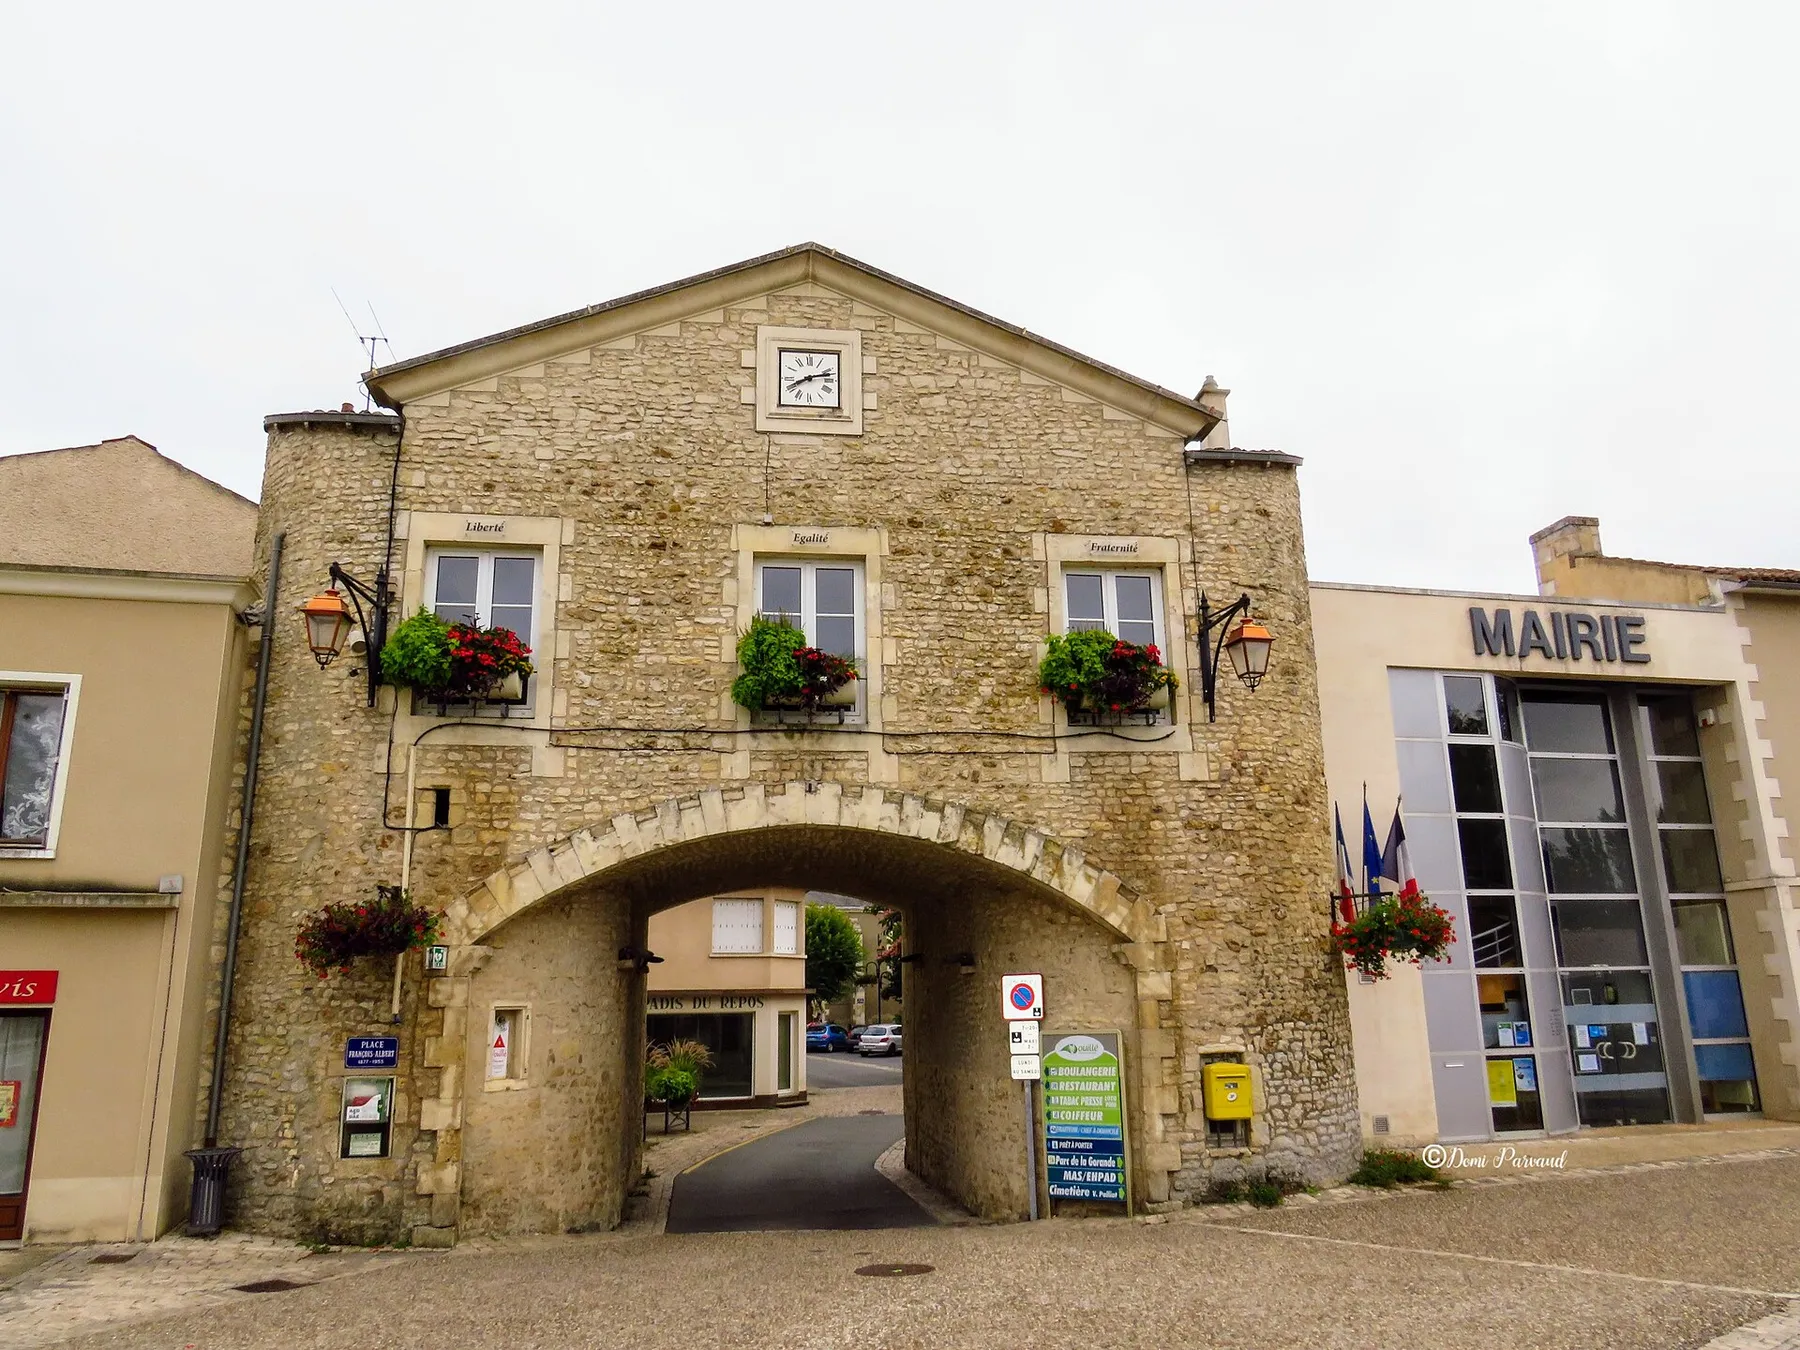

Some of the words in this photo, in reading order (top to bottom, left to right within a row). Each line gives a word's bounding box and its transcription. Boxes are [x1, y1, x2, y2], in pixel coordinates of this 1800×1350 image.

[465, 520, 505, 532] Liberté
[793, 532, 829, 545] Egalité
[1091, 541, 1138, 553] Fraternité
[1469, 607, 1651, 663] MAIRIE
[646, 996, 684, 1010] ADIS
[692, 996, 712, 1009] DU
[720, 995, 765, 1009] REPOS
[361, 1041, 385, 1049] PLACE
[1058, 1066, 1116, 1077] BOULANGERIE
[1060, 1081, 1117, 1092] RESTAURANT
[1060, 1110, 1104, 1121] COIFFEUR
[1056, 1155, 1070, 1166] Parc
[1071, 1155, 1079, 1167] de
[1080, 1155, 1088, 1167] la
[1063, 1171, 1117, 1183] MAS/EHPAD
[1049, 1184, 1090, 1197] Cimetière
